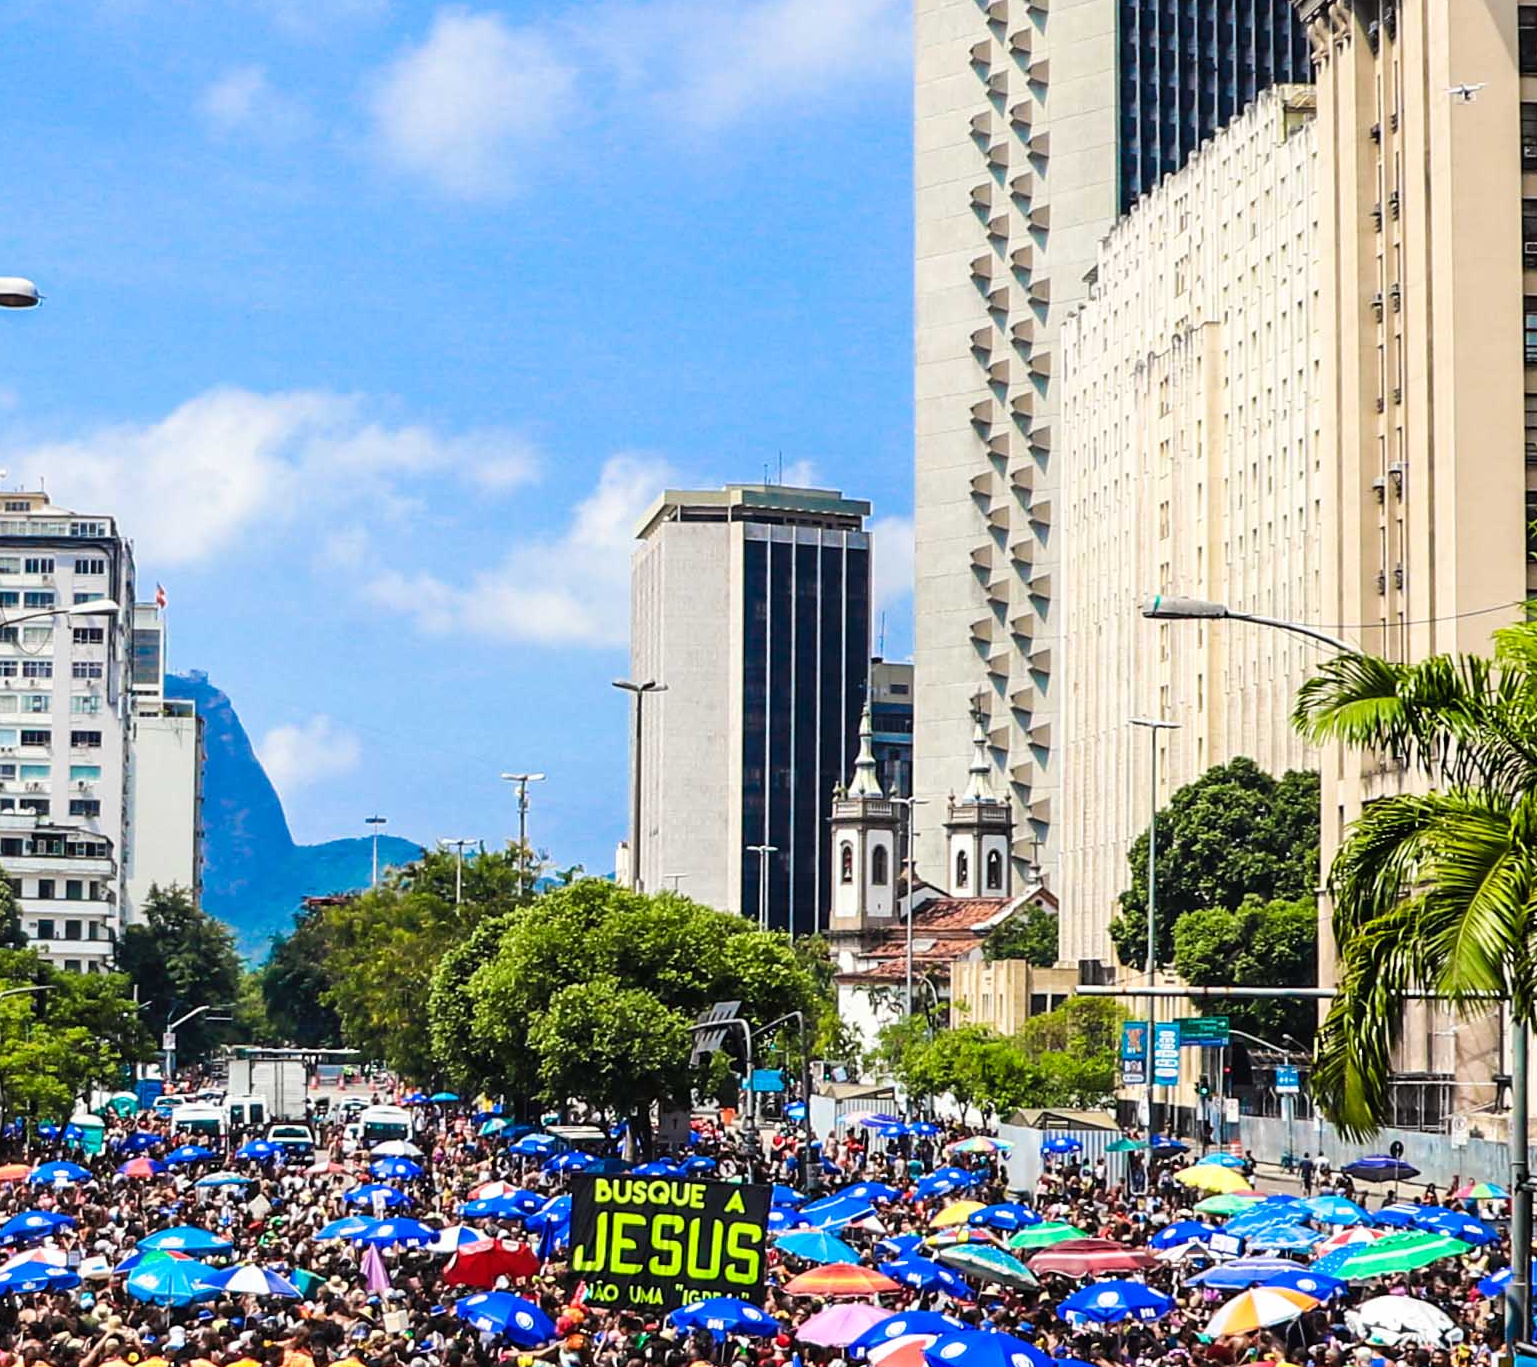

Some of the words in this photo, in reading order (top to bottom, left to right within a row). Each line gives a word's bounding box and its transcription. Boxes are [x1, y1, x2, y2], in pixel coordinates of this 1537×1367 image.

[595, 1179, 706, 1210] BUSQUE
[724, 1190, 746, 1214] A
[573, 1211, 763, 1285] JESUS
[588, 1280, 620, 1304] NÃO
[629, 1285, 664, 1306] UMA
